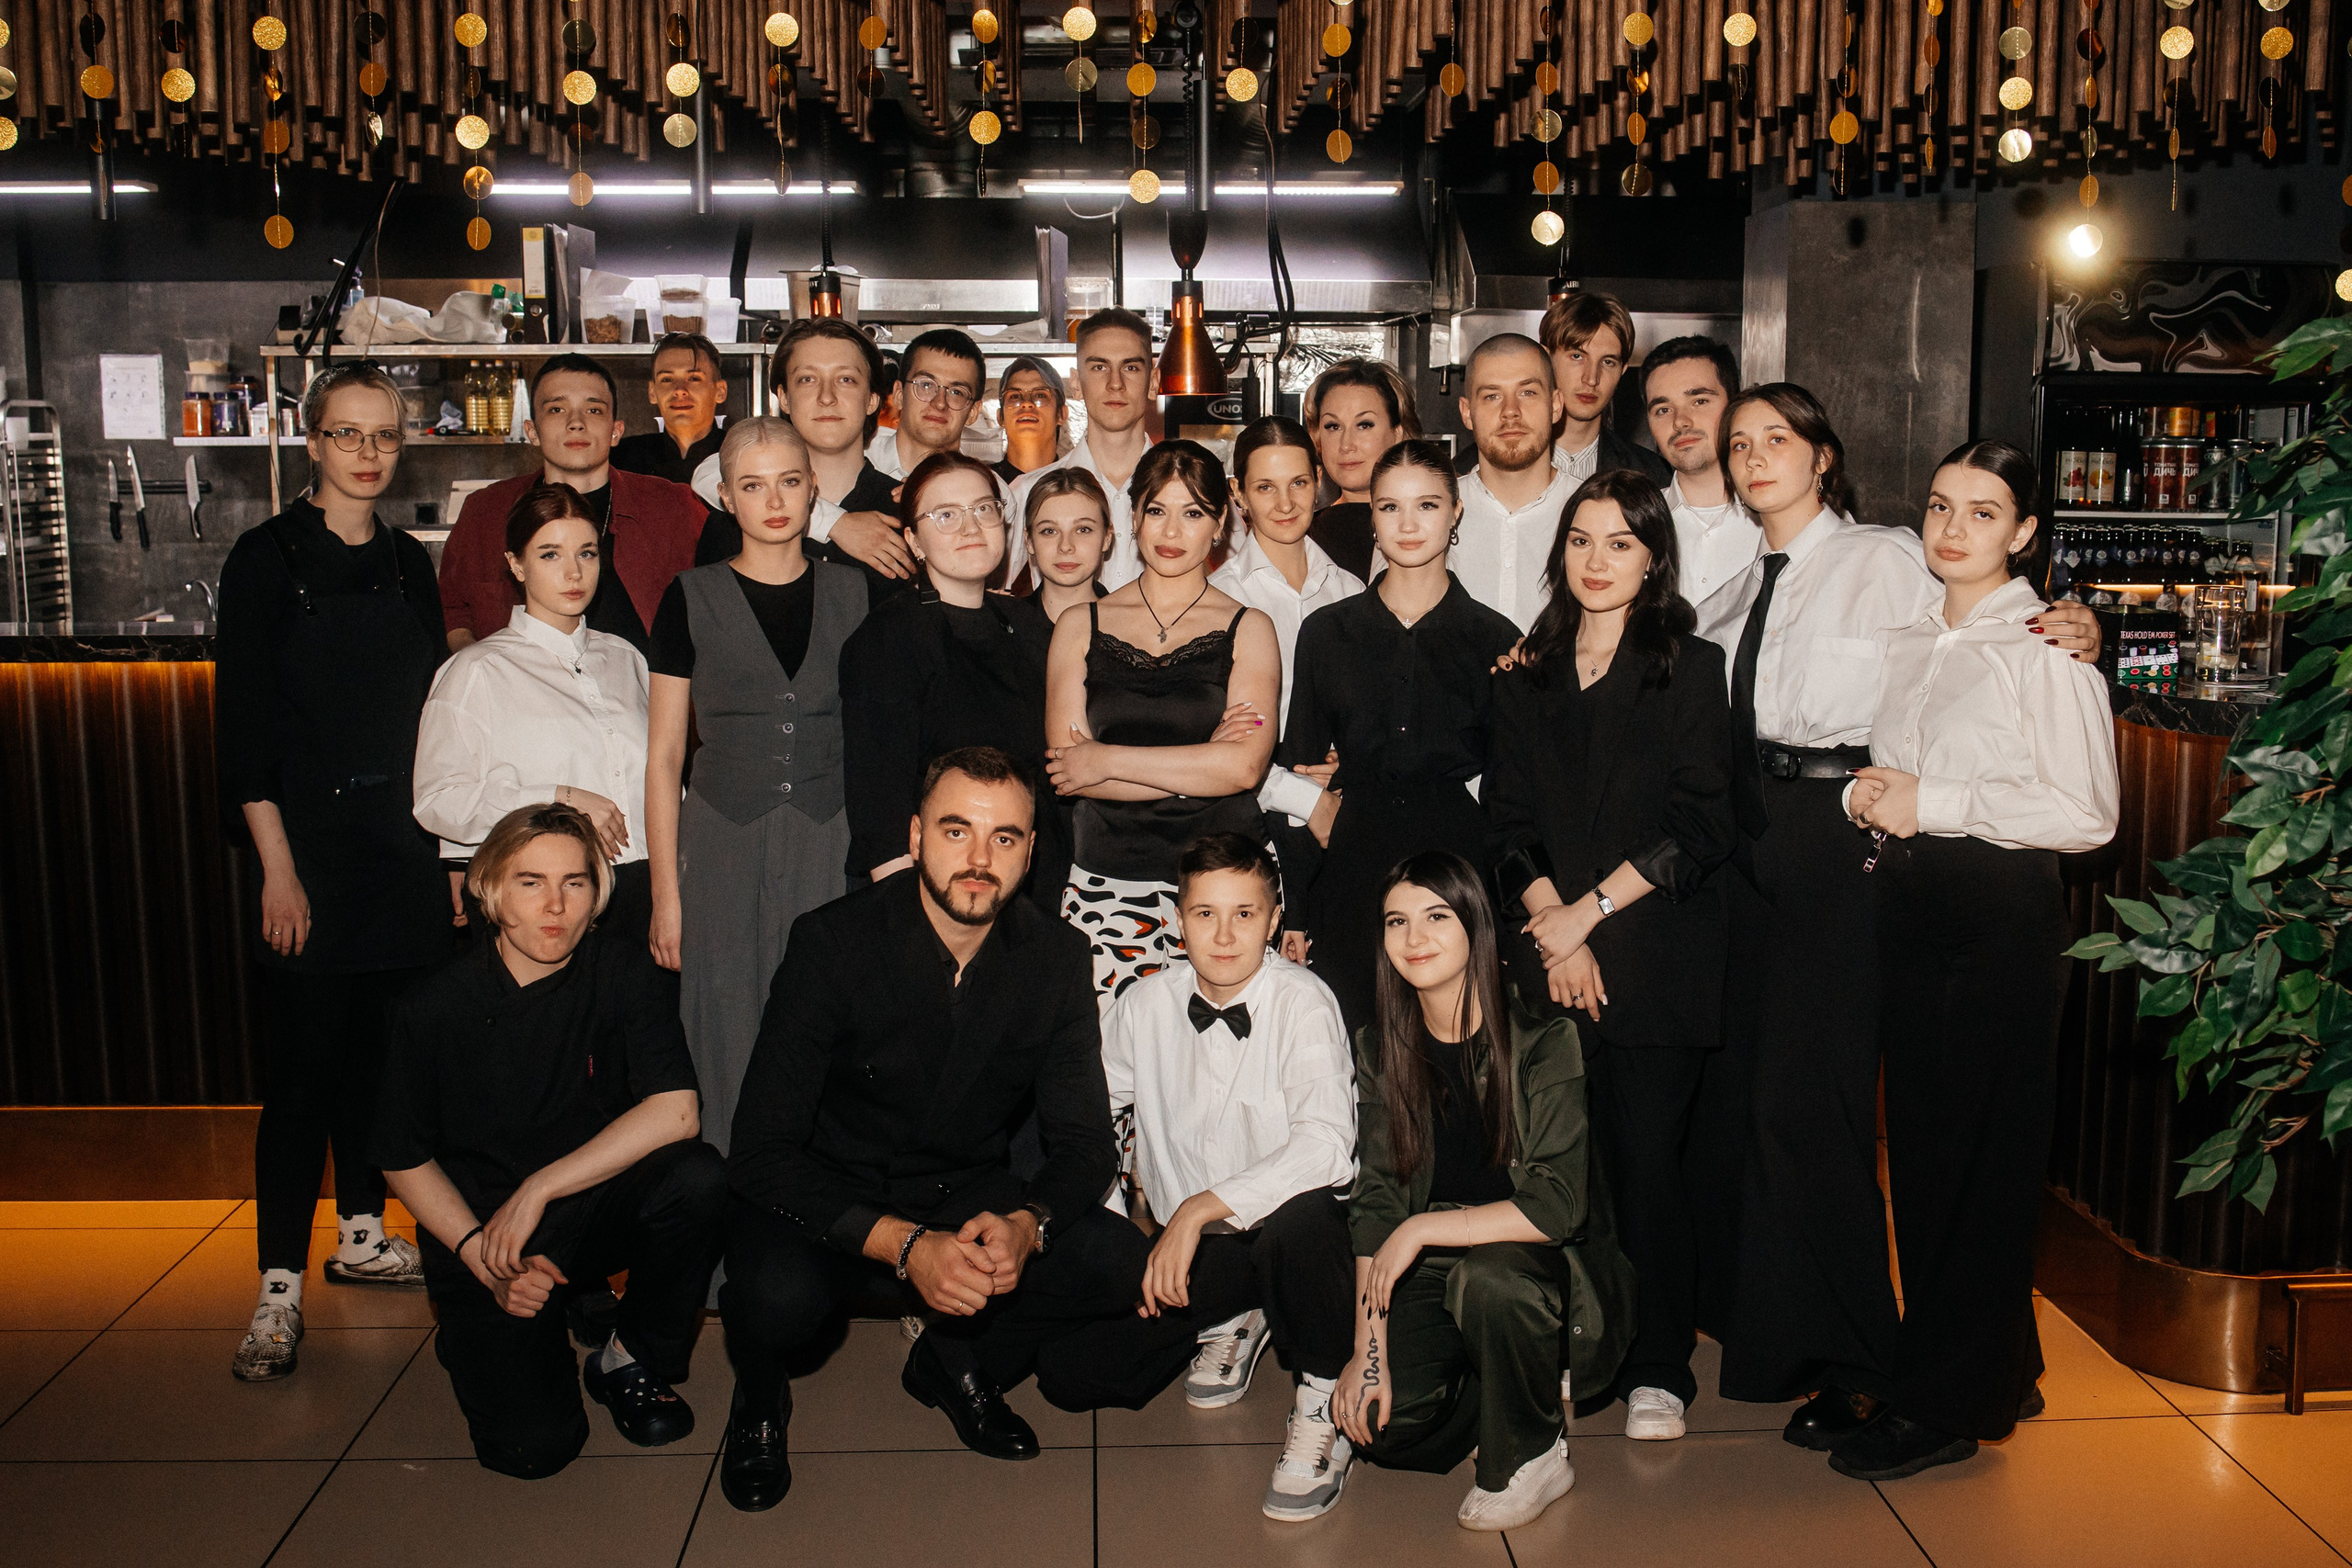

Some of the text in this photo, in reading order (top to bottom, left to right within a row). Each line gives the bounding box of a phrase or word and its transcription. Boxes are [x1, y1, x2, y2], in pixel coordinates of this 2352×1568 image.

[1213, 404, 1242, 413] UNO
[2154, 467, 2177, 478] ДИЧЬ
[2182, 467, 2199, 478] ДИЧ
[2120, 630, 2134, 639] TEXAS
[2155, 631, 2168, 639] POKER
